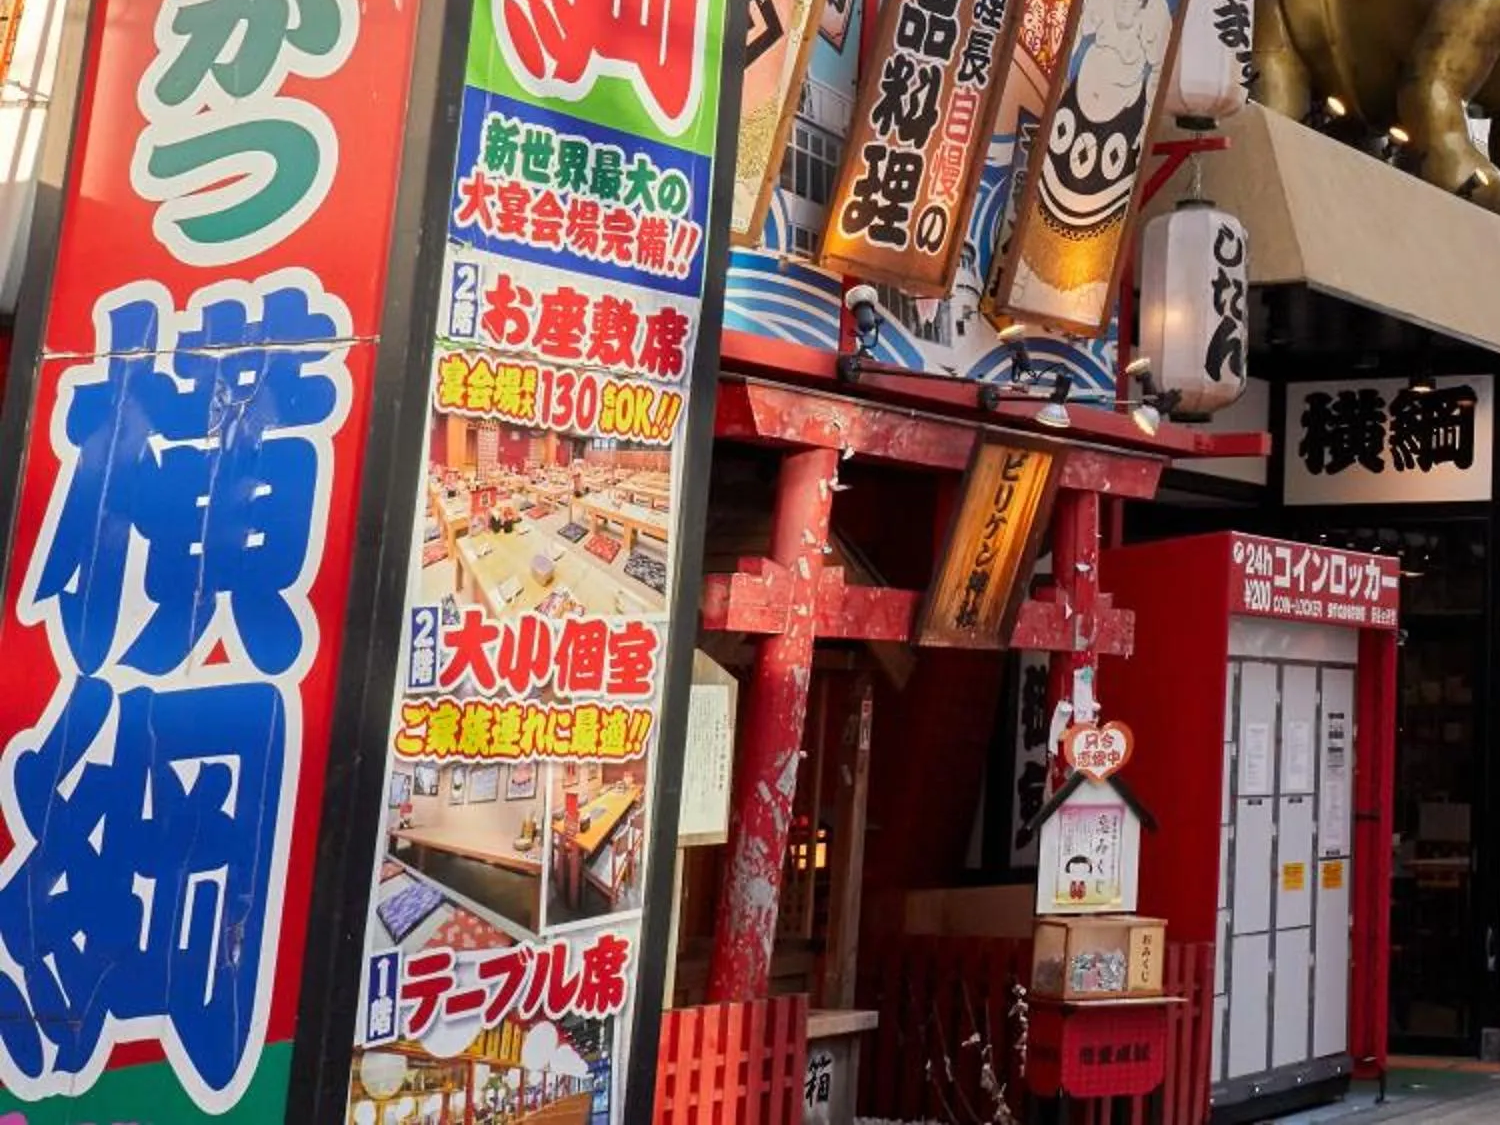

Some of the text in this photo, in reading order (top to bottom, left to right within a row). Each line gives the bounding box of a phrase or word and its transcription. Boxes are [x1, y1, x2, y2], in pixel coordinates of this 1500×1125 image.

[484, 116, 687, 215] 新世界最大の
[481, 275, 688, 375] お座敷席
[1298, 386, 1478, 474] 横綱
[0, 287, 337, 1092] 横綱
[440, 614, 658, 695] 大小個室
[402, 935, 630, 1036] テーブル席
